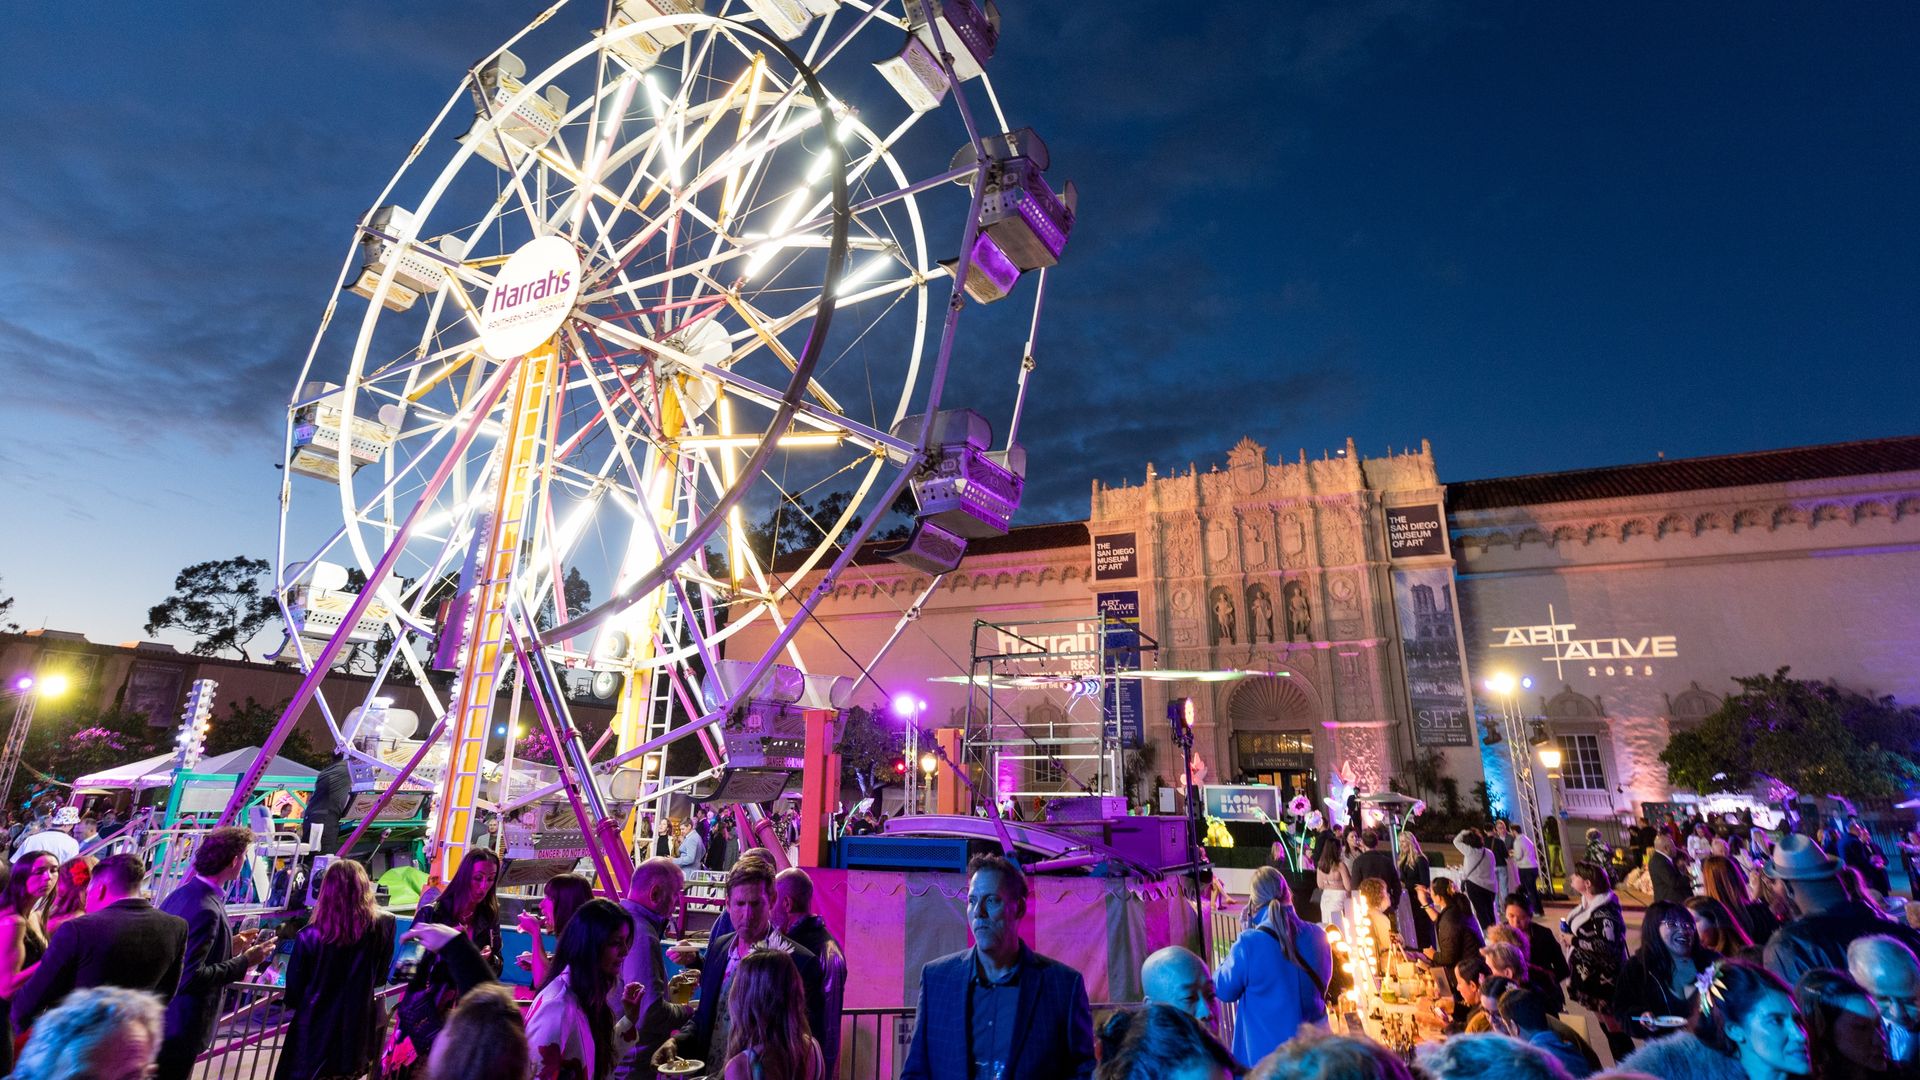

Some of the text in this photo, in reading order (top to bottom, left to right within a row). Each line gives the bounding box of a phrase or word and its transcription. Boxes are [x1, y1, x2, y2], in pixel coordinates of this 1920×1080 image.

[1389, 516, 1407, 524] THE
[1390, 521, 1438, 532] SAN DIEGO
[1392, 530, 1431, 540] MUSEUM
[1096, 542, 1111, 550] THE
[1392, 539, 1425, 548] OF ART
[1112, 547, 1135, 556] DIEGO
[1097, 555, 1129, 564] MUSEUM
[1108, 563, 1123, 571] ART
[1107, 603, 1135, 611] ALIVE
[1503, 624, 1576, 646] ART
[1564, 635, 1678, 660] ALIVE
[1588, 666, 1653, 677] 2025
[1418, 710, 1463, 729] SEE
[1220, 794, 1258, 804] BLOOM
